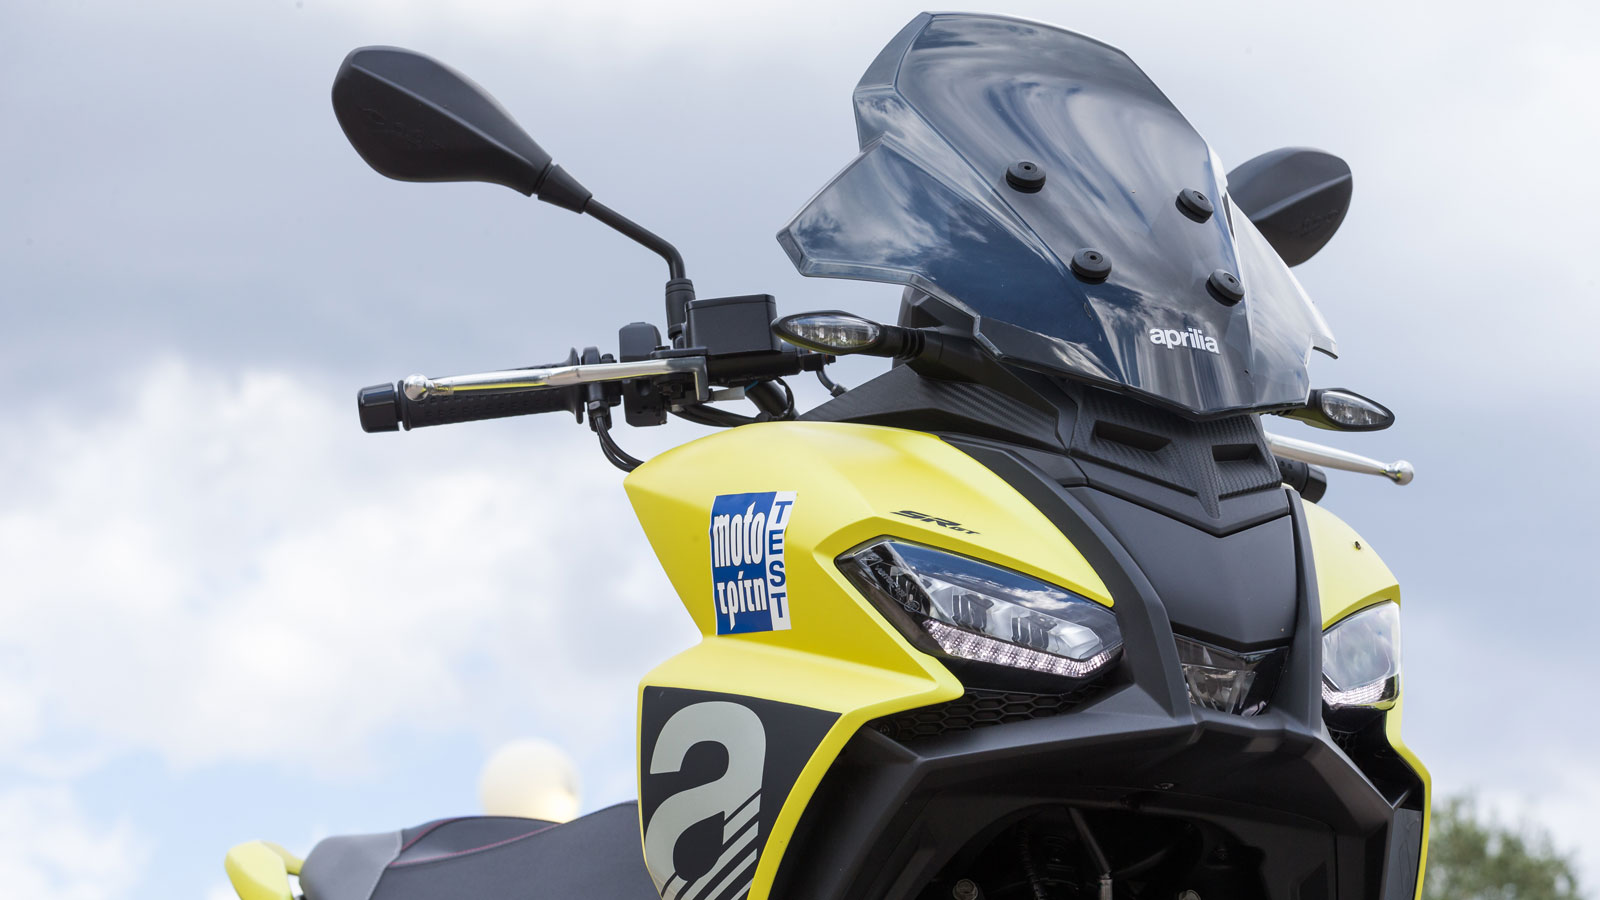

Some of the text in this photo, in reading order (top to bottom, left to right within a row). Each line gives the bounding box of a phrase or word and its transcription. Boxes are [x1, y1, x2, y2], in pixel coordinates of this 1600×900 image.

[1149, 327, 1220, 354] aprilia
[713, 501, 766, 568] moto
[768, 500, 793, 619] TEST
